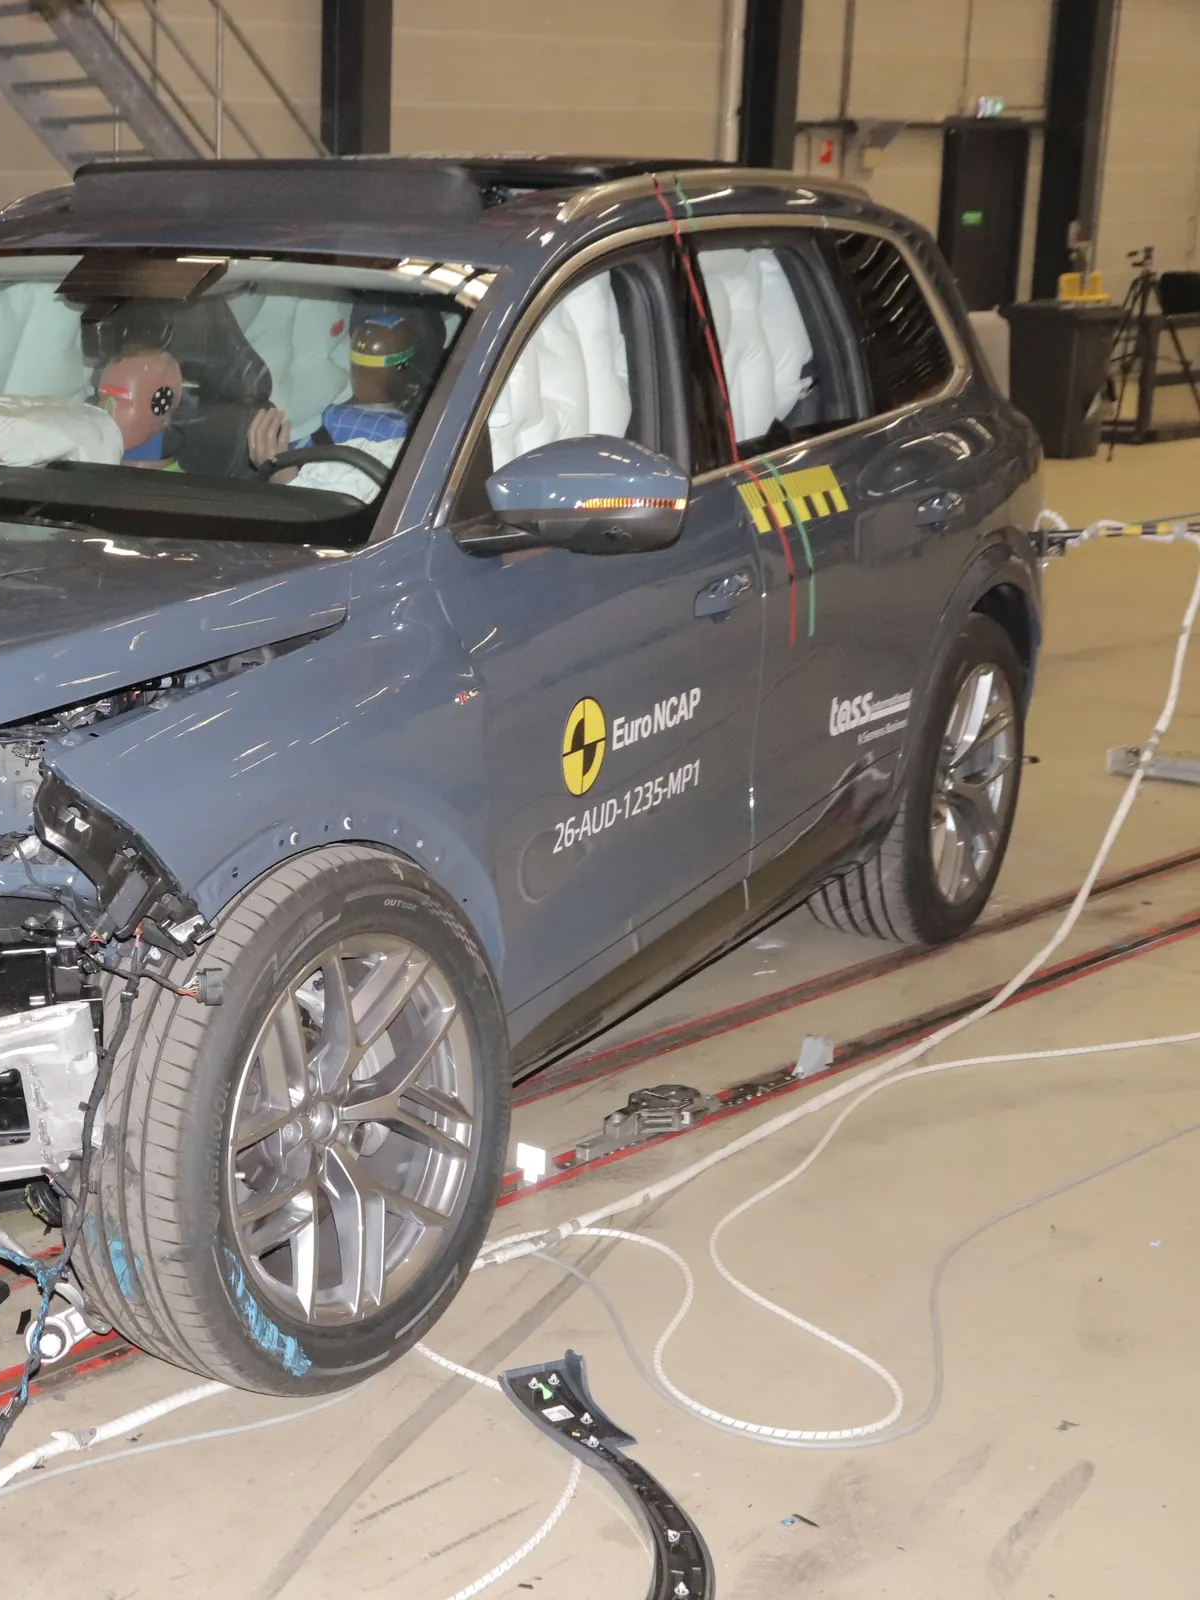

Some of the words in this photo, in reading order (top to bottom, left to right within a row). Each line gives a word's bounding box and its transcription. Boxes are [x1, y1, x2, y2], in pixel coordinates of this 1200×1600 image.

[612, 714, 653, 751] Euro
[653, 687, 701, 735] NCAP
[552, 758, 701, 855] 26-AUD-1235-MP1
[383, 898, 418, 912] OUTSIDE
